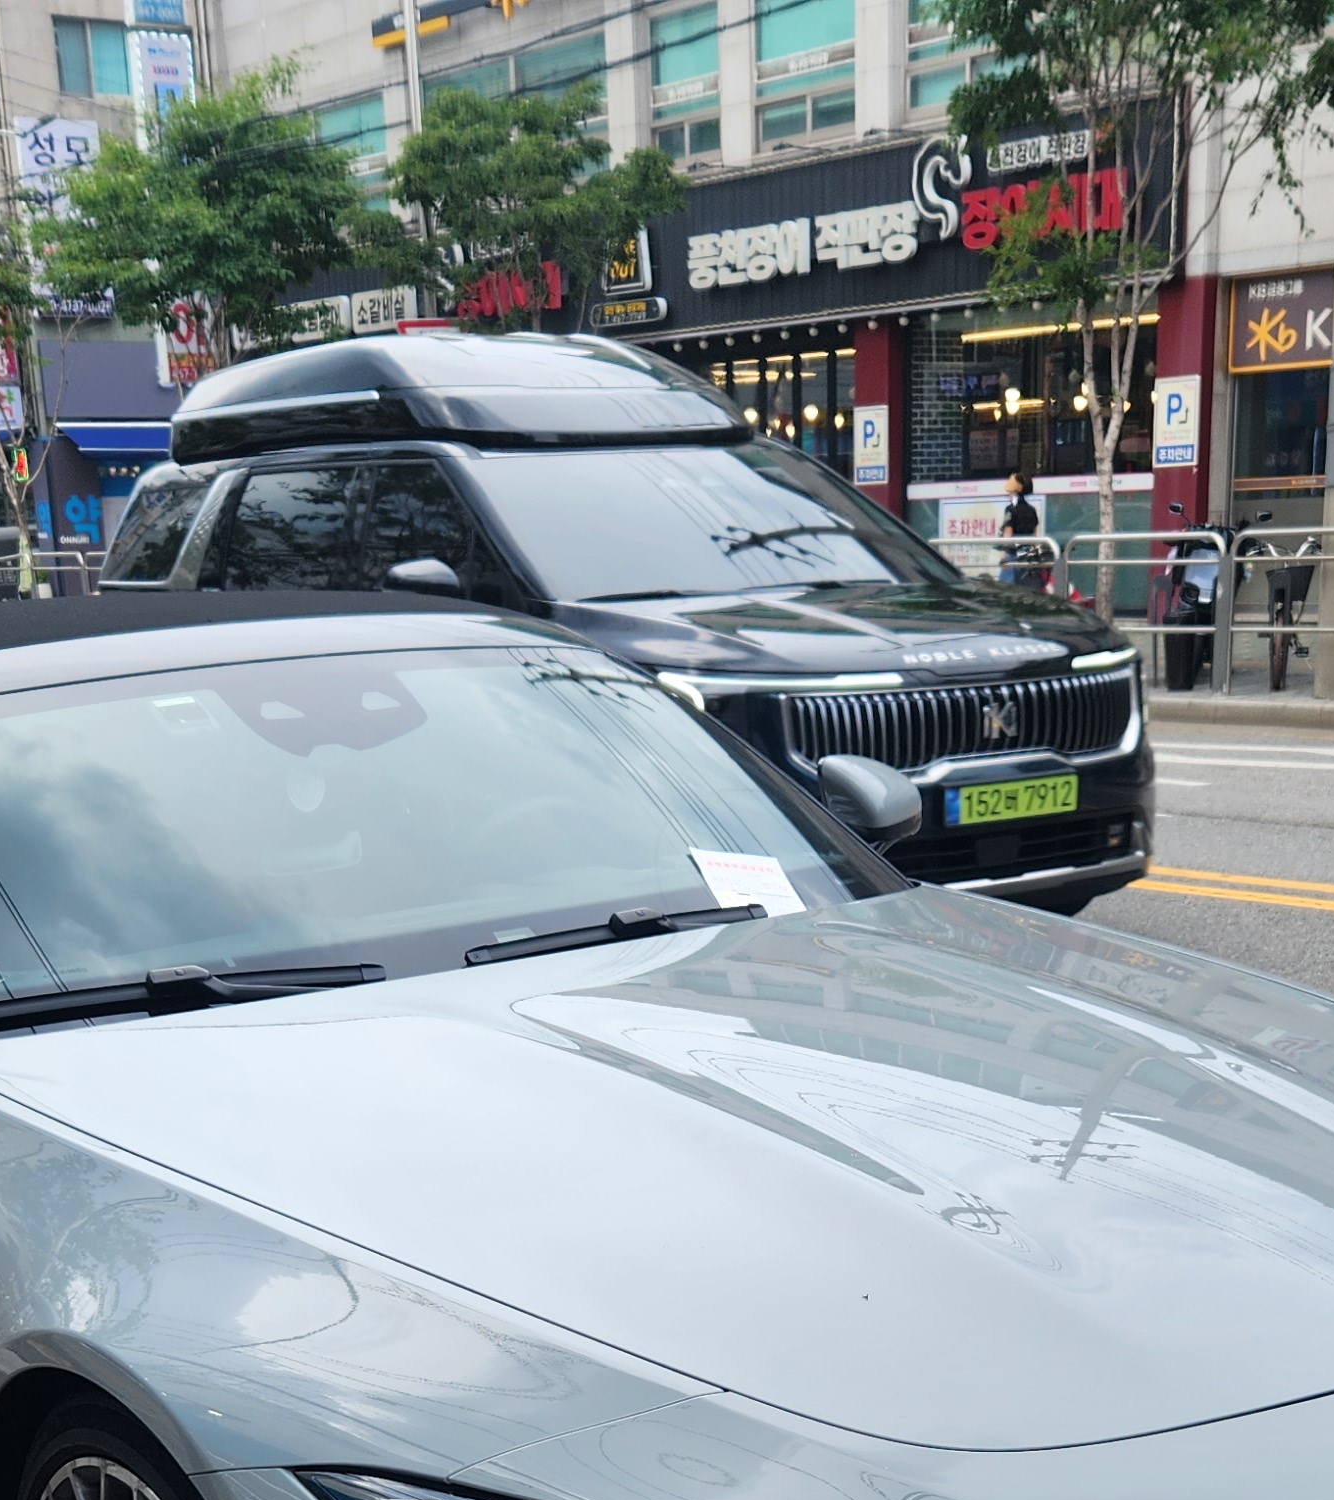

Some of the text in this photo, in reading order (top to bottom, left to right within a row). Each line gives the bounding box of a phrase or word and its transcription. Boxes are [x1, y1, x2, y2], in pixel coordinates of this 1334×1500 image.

[28, 131, 90, 167] 성모
[687, 200, 921, 291] 풍천장어 직판장
[1166, 393, 1183, 425] P
[863, 420, 876, 448] P
[948, 518, 997, 537] 주차안내
[902, 643, 1061, 664] NOBLE KLASSE
[1024, 780, 1074, 814] 7912
